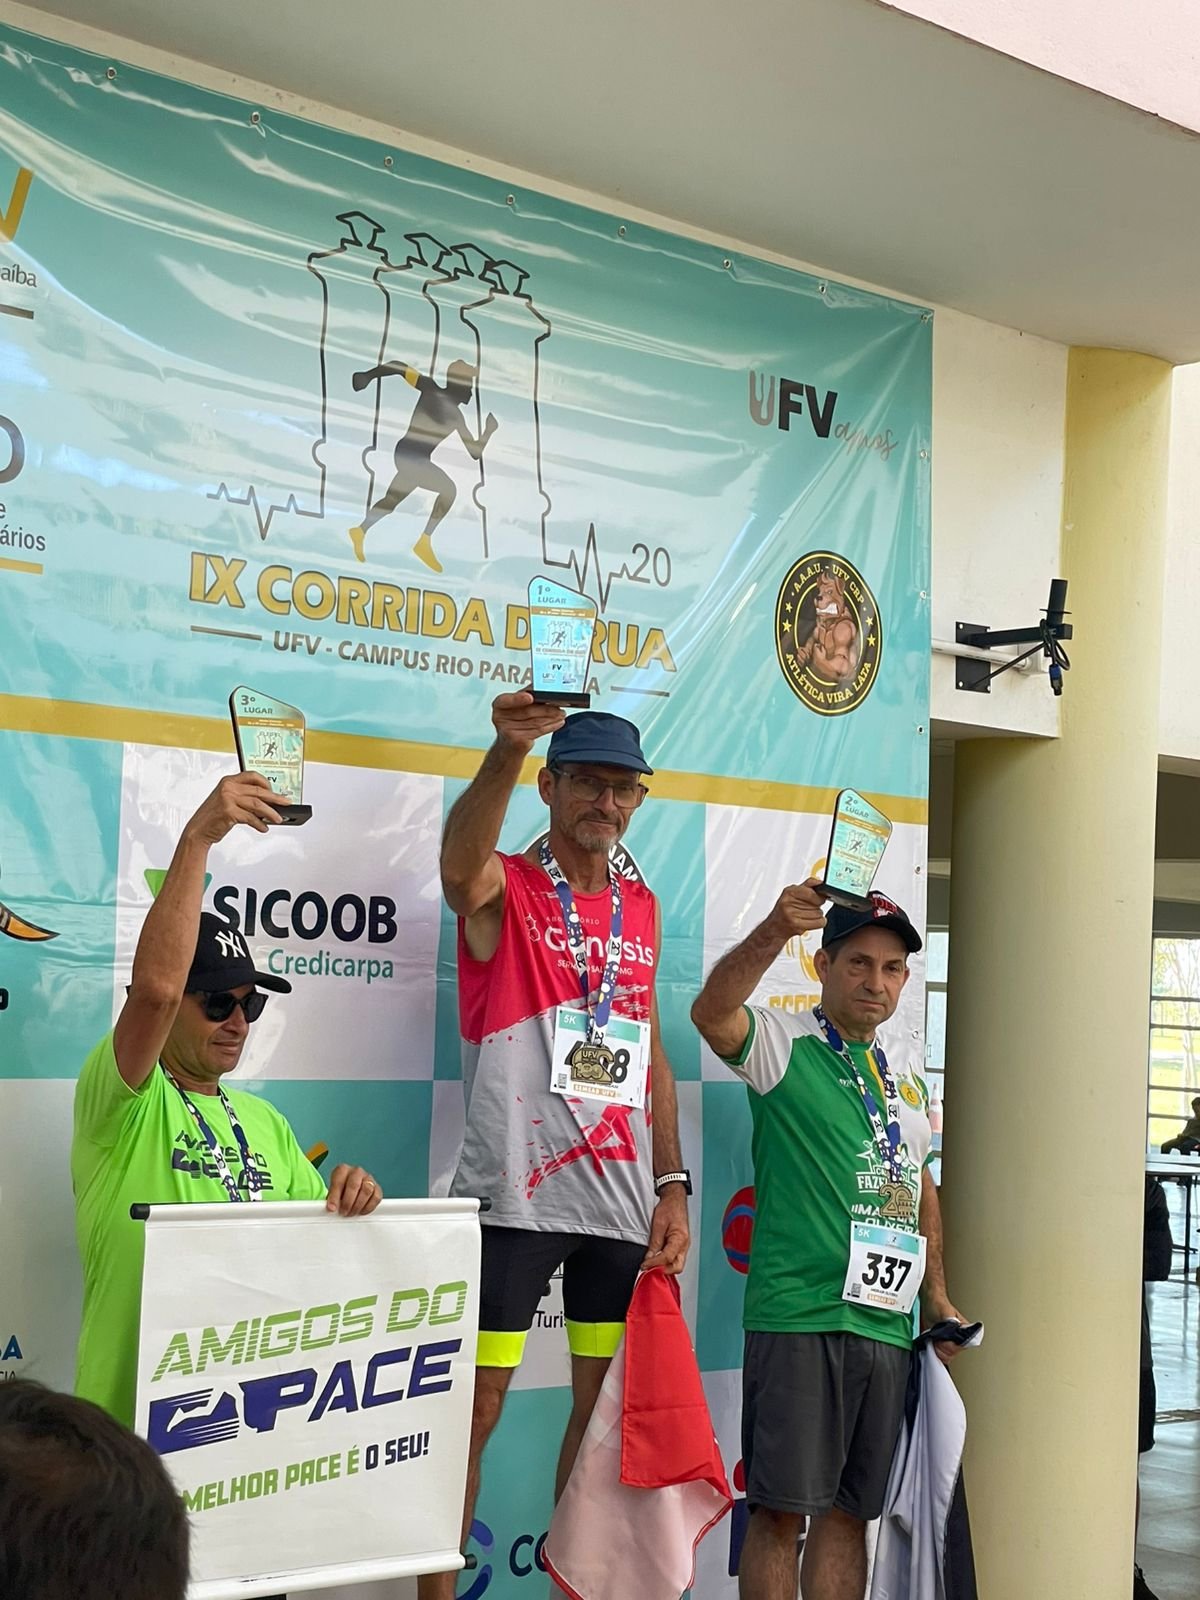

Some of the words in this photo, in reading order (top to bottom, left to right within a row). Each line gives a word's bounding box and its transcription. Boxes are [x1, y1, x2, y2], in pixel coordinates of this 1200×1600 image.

[632, 542, 672, 588] 20
[832, 564, 851, 581] UFV
[188, 551, 248, 609] IX
[256, 563, 496, 647] CORRIDA
[504, 603, 533, 652] D
[591, 618, 678, 673] RUA
[537, 596, 567, 605] LUGAR
[273, 630, 323, 657] UFV
[338, 639, 430, 673] CAMPUS
[436, 650, 474, 679] RIO
[785, 653, 825, 703] ATLÉTICA
[826, 687, 854, 704] VIRA
[852, 661, 872, 692] LATA
[243, 706, 273, 715] LUGAR
[845, 805, 870, 819] LUGAR
[213, 885, 398, 944] SICOOB
[267, 949, 395, 985] Credicarpa
[544, 926, 654, 967] Gnsis
[563, 1014, 577, 1025] 5K
[858, 1228, 870, 1238] 5K
[861, 1251, 913, 1293] 337
[151, 1294, 378, 1383] AMIGOS
[386, 1280, 468, 1334] DO
[238, 1338, 463, 1434] PACE
[182, 1468, 279, 1514] MELHOR
[285, 1453, 342, 1492] PACE
[346, 1444, 360, 1475] É
[365, 1444, 380, 1472] O
[384, 1431, 431, 1467] SEU!
